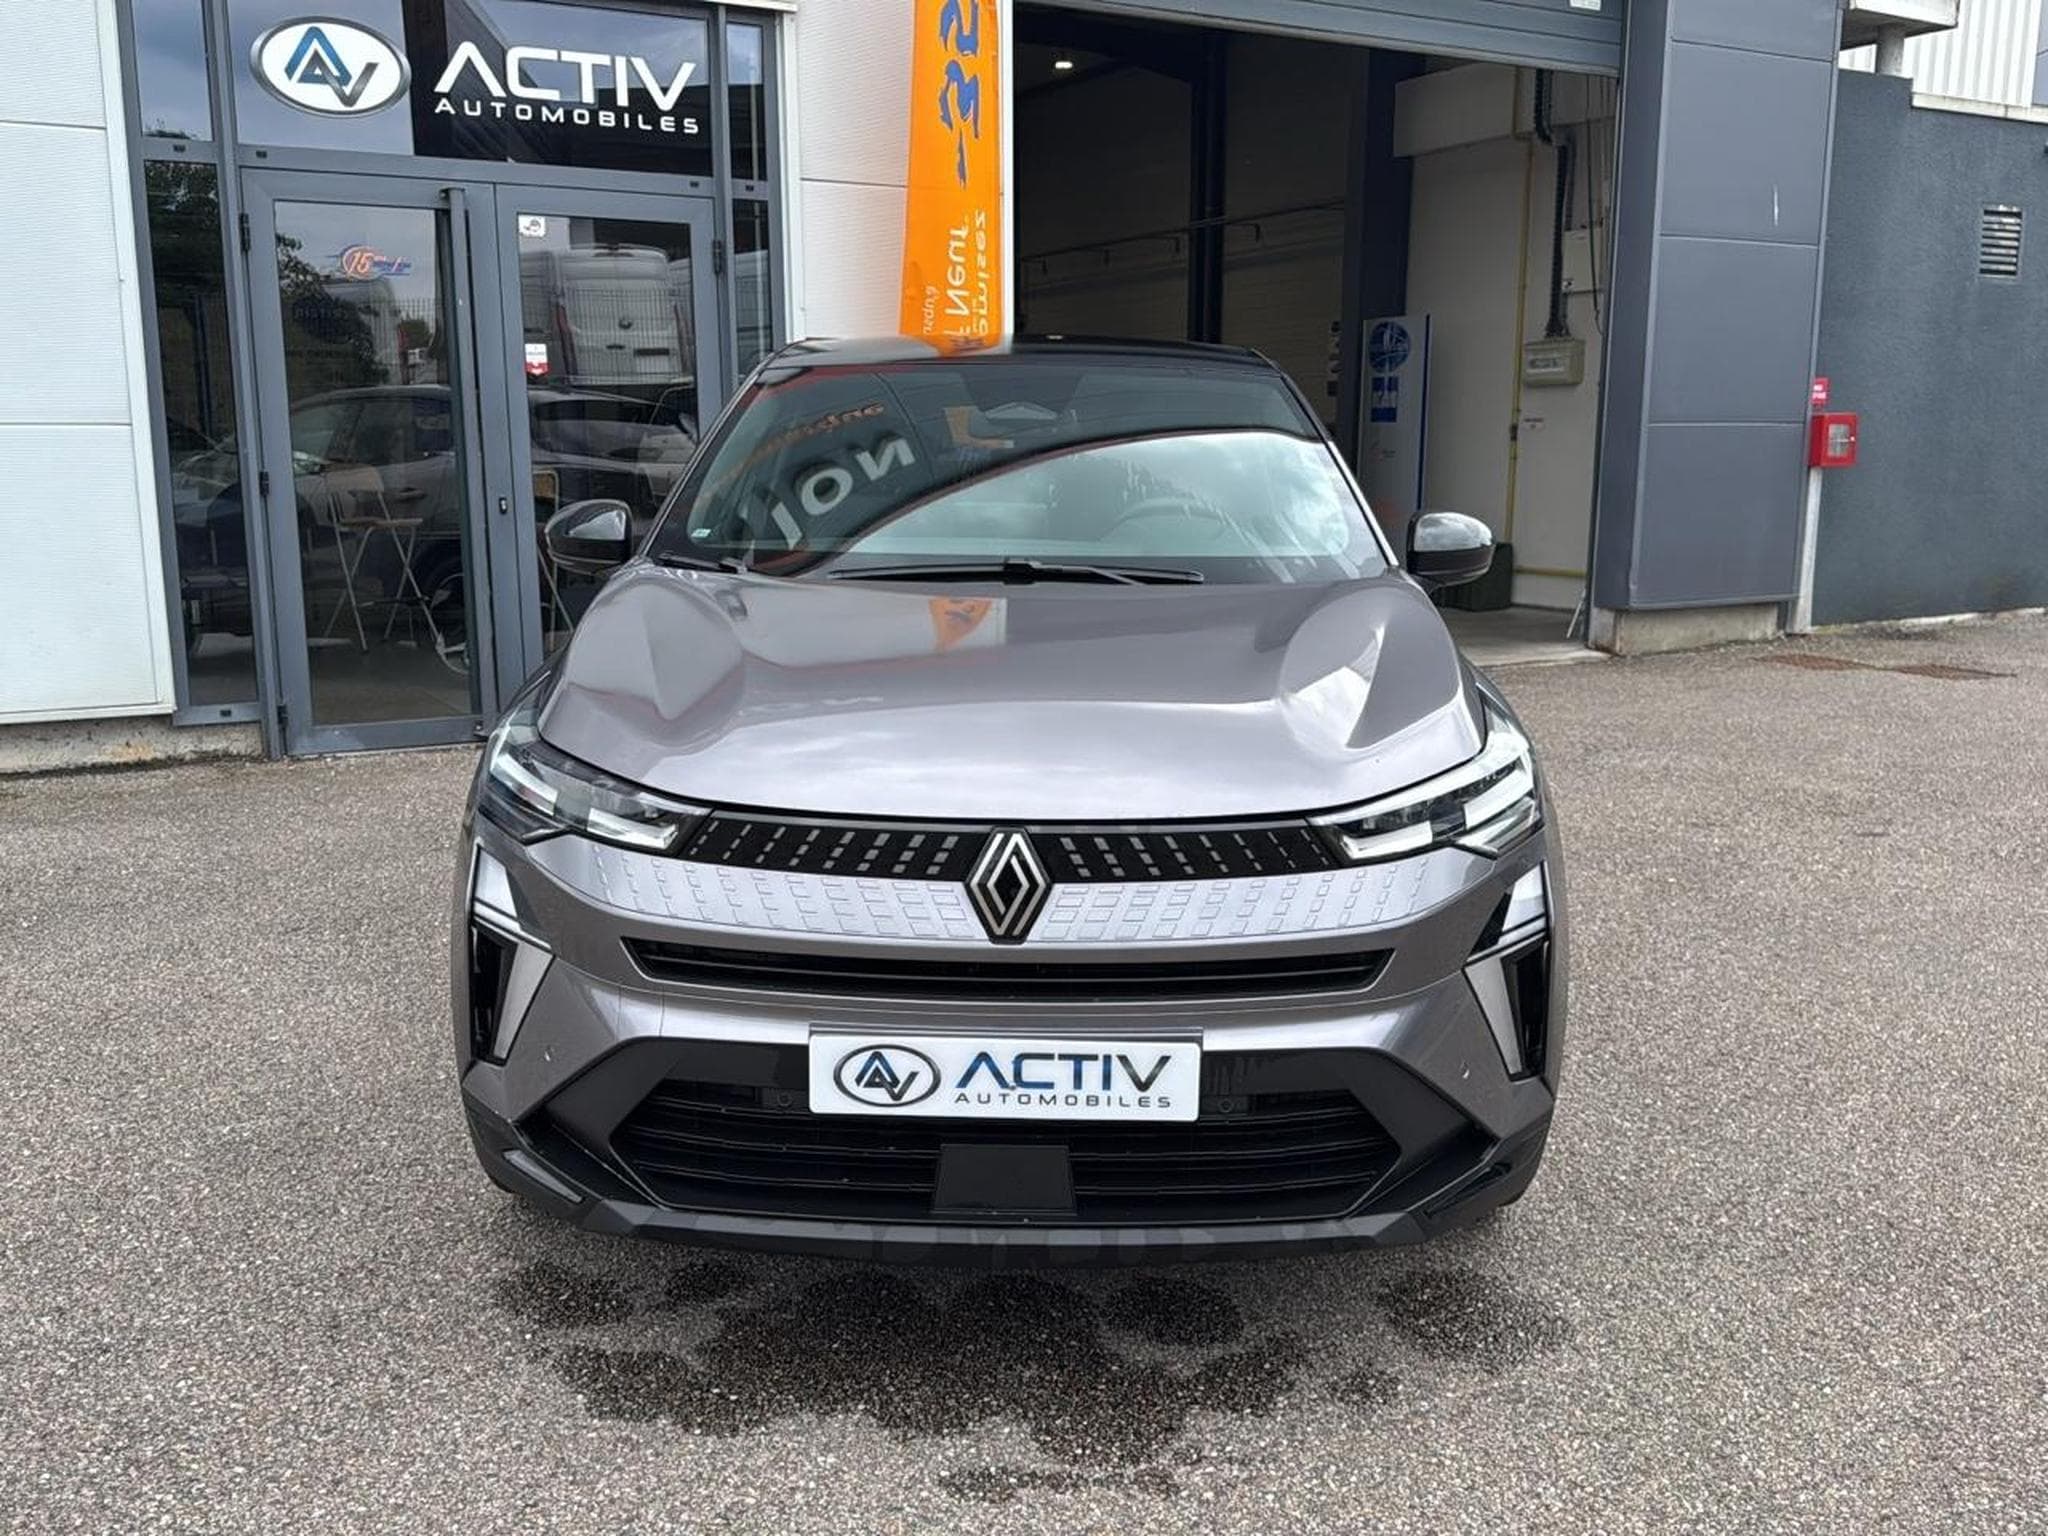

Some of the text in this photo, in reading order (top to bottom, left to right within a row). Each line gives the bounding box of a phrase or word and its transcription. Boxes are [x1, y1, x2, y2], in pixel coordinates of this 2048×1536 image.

[434, 40, 696, 111] ACTIV
[434, 97, 699, 135] AUTOMOBILES
[955, 1051, 1172, 1092] ACTIV
[954, 1092, 1171, 1108] AUTOMOBILES
